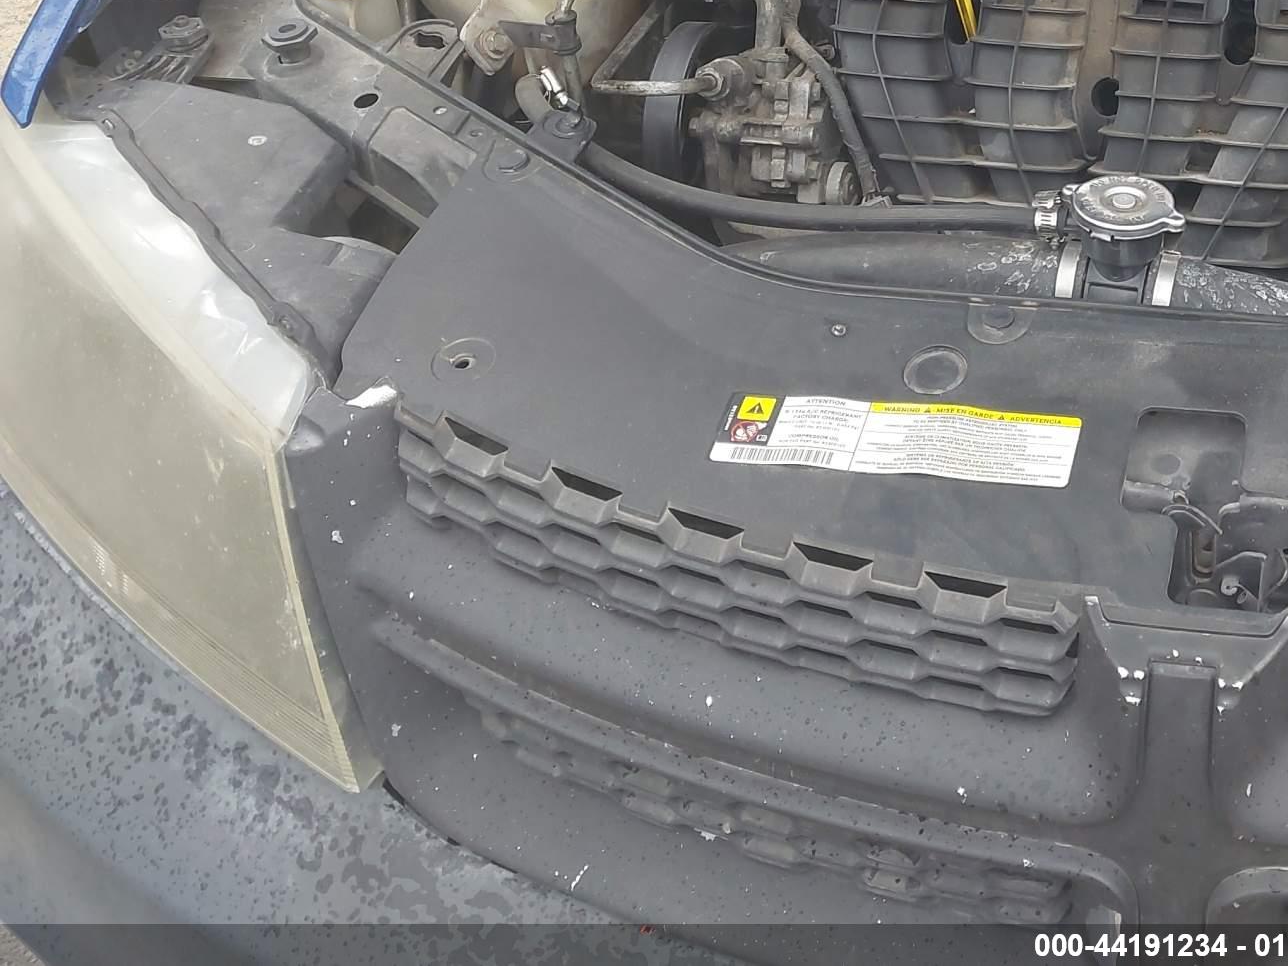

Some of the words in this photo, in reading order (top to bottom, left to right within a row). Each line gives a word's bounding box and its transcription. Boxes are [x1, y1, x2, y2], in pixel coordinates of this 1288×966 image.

[806, 398, 846, 406] ATTENTION
[884, 405, 921, 413] WARNING
[968, 410, 994, 420] GARDE
[1010, 416, 1062, 425] ADVERTENCIA
